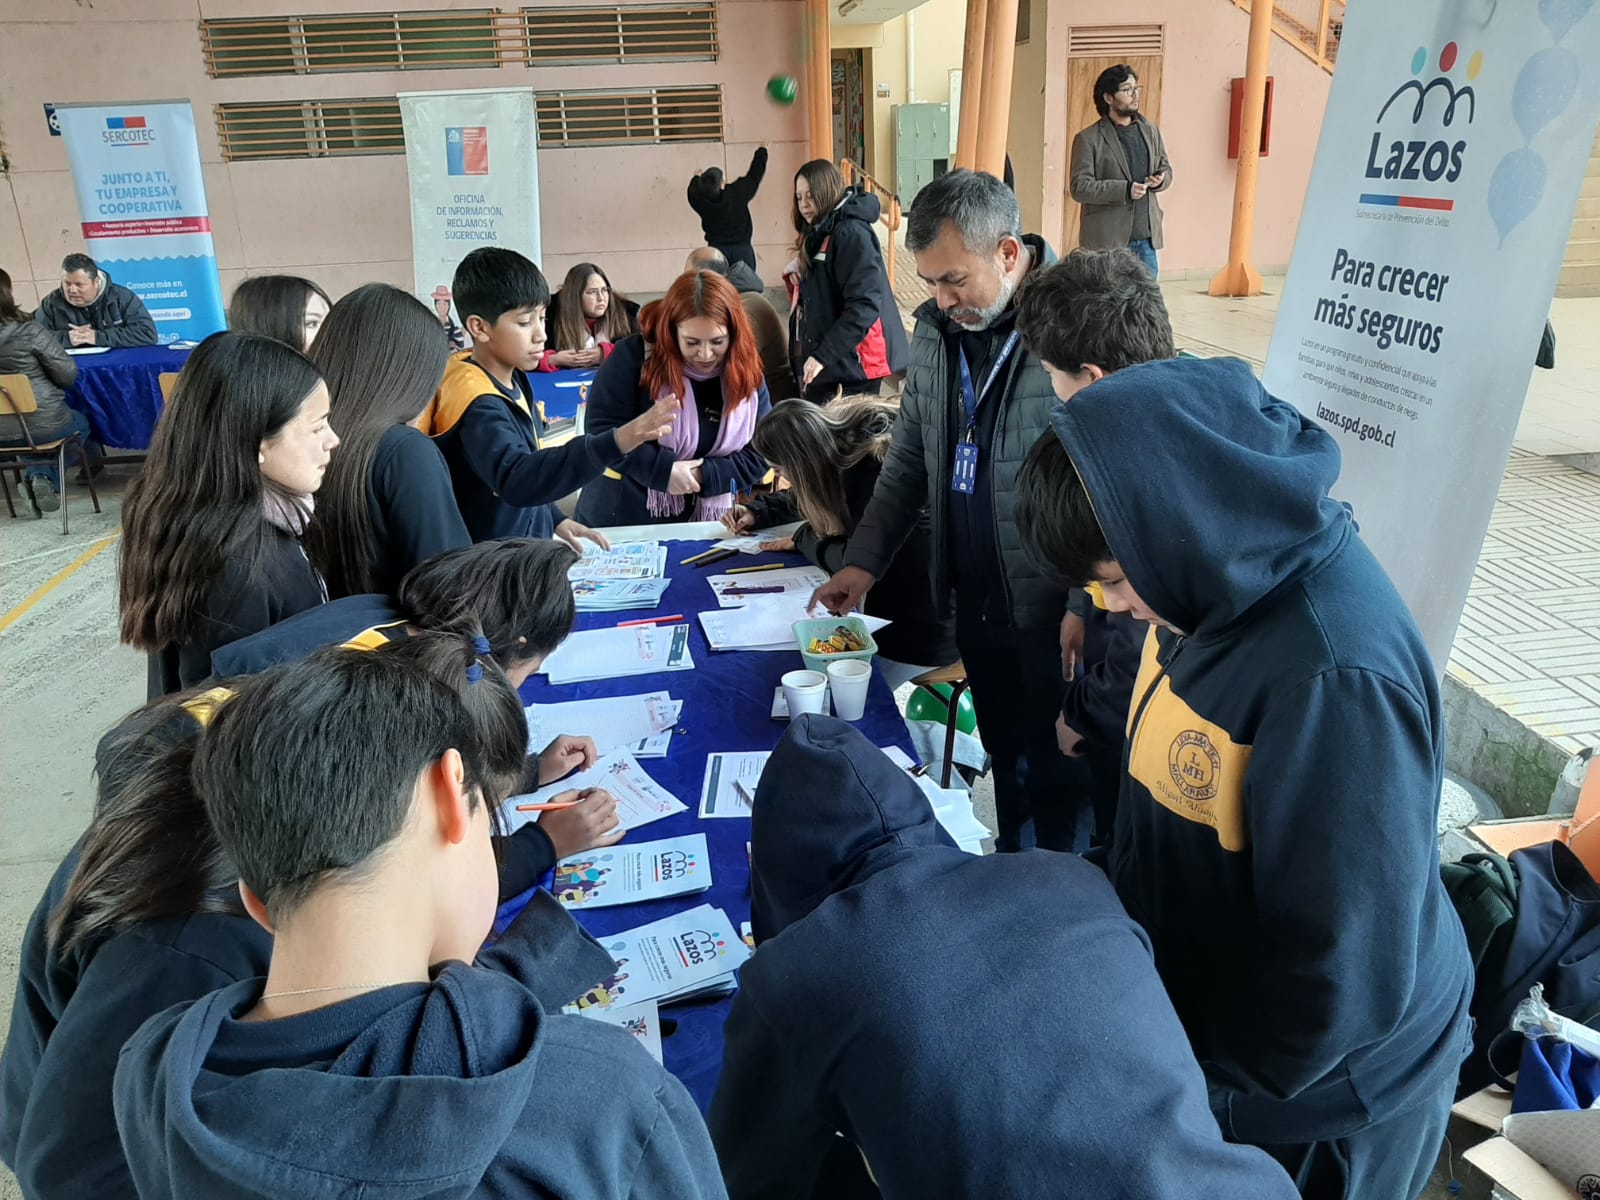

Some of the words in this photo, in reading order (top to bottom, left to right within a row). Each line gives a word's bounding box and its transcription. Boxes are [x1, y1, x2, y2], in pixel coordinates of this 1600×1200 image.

[102, 129, 156, 143] SERCOTEC
[1365, 132, 1467, 183] Lazos
[102, 172, 143, 185] JUNTO
[145, 171, 154, 183] A
[154, 171, 170, 184] TI,
[95, 189, 112, 201] TU
[114, 185, 169, 199] EMPRESA
[169, 185, 177, 197] Y
[454, 194, 485, 204] OFICINA
[99, 200, 183, 215] COOPERATIVA
[436, 207, 448, 216] DE
[447, 219, 488, 228] RECLAMOS
[489, 219, 494, 227] Y
[445, 231, 497, 240] SUGERENCIAS
[1331, 248, 1375, 288] Para
[1377, 264, 1449, 303] crecer
[126, 281, 155, 290] Conoce
[156, 279, 171, 289] más
[173, 280, 183, 288] en
[1314, 293, 1356, 330] más
[1356, 306, 1443, 354] seguros
[1316, 401, 1396, 448] lazos.spd.gob.cl
[661, 851, 673, 881] Lazos
[680, 931, 704, 965] Lazos
